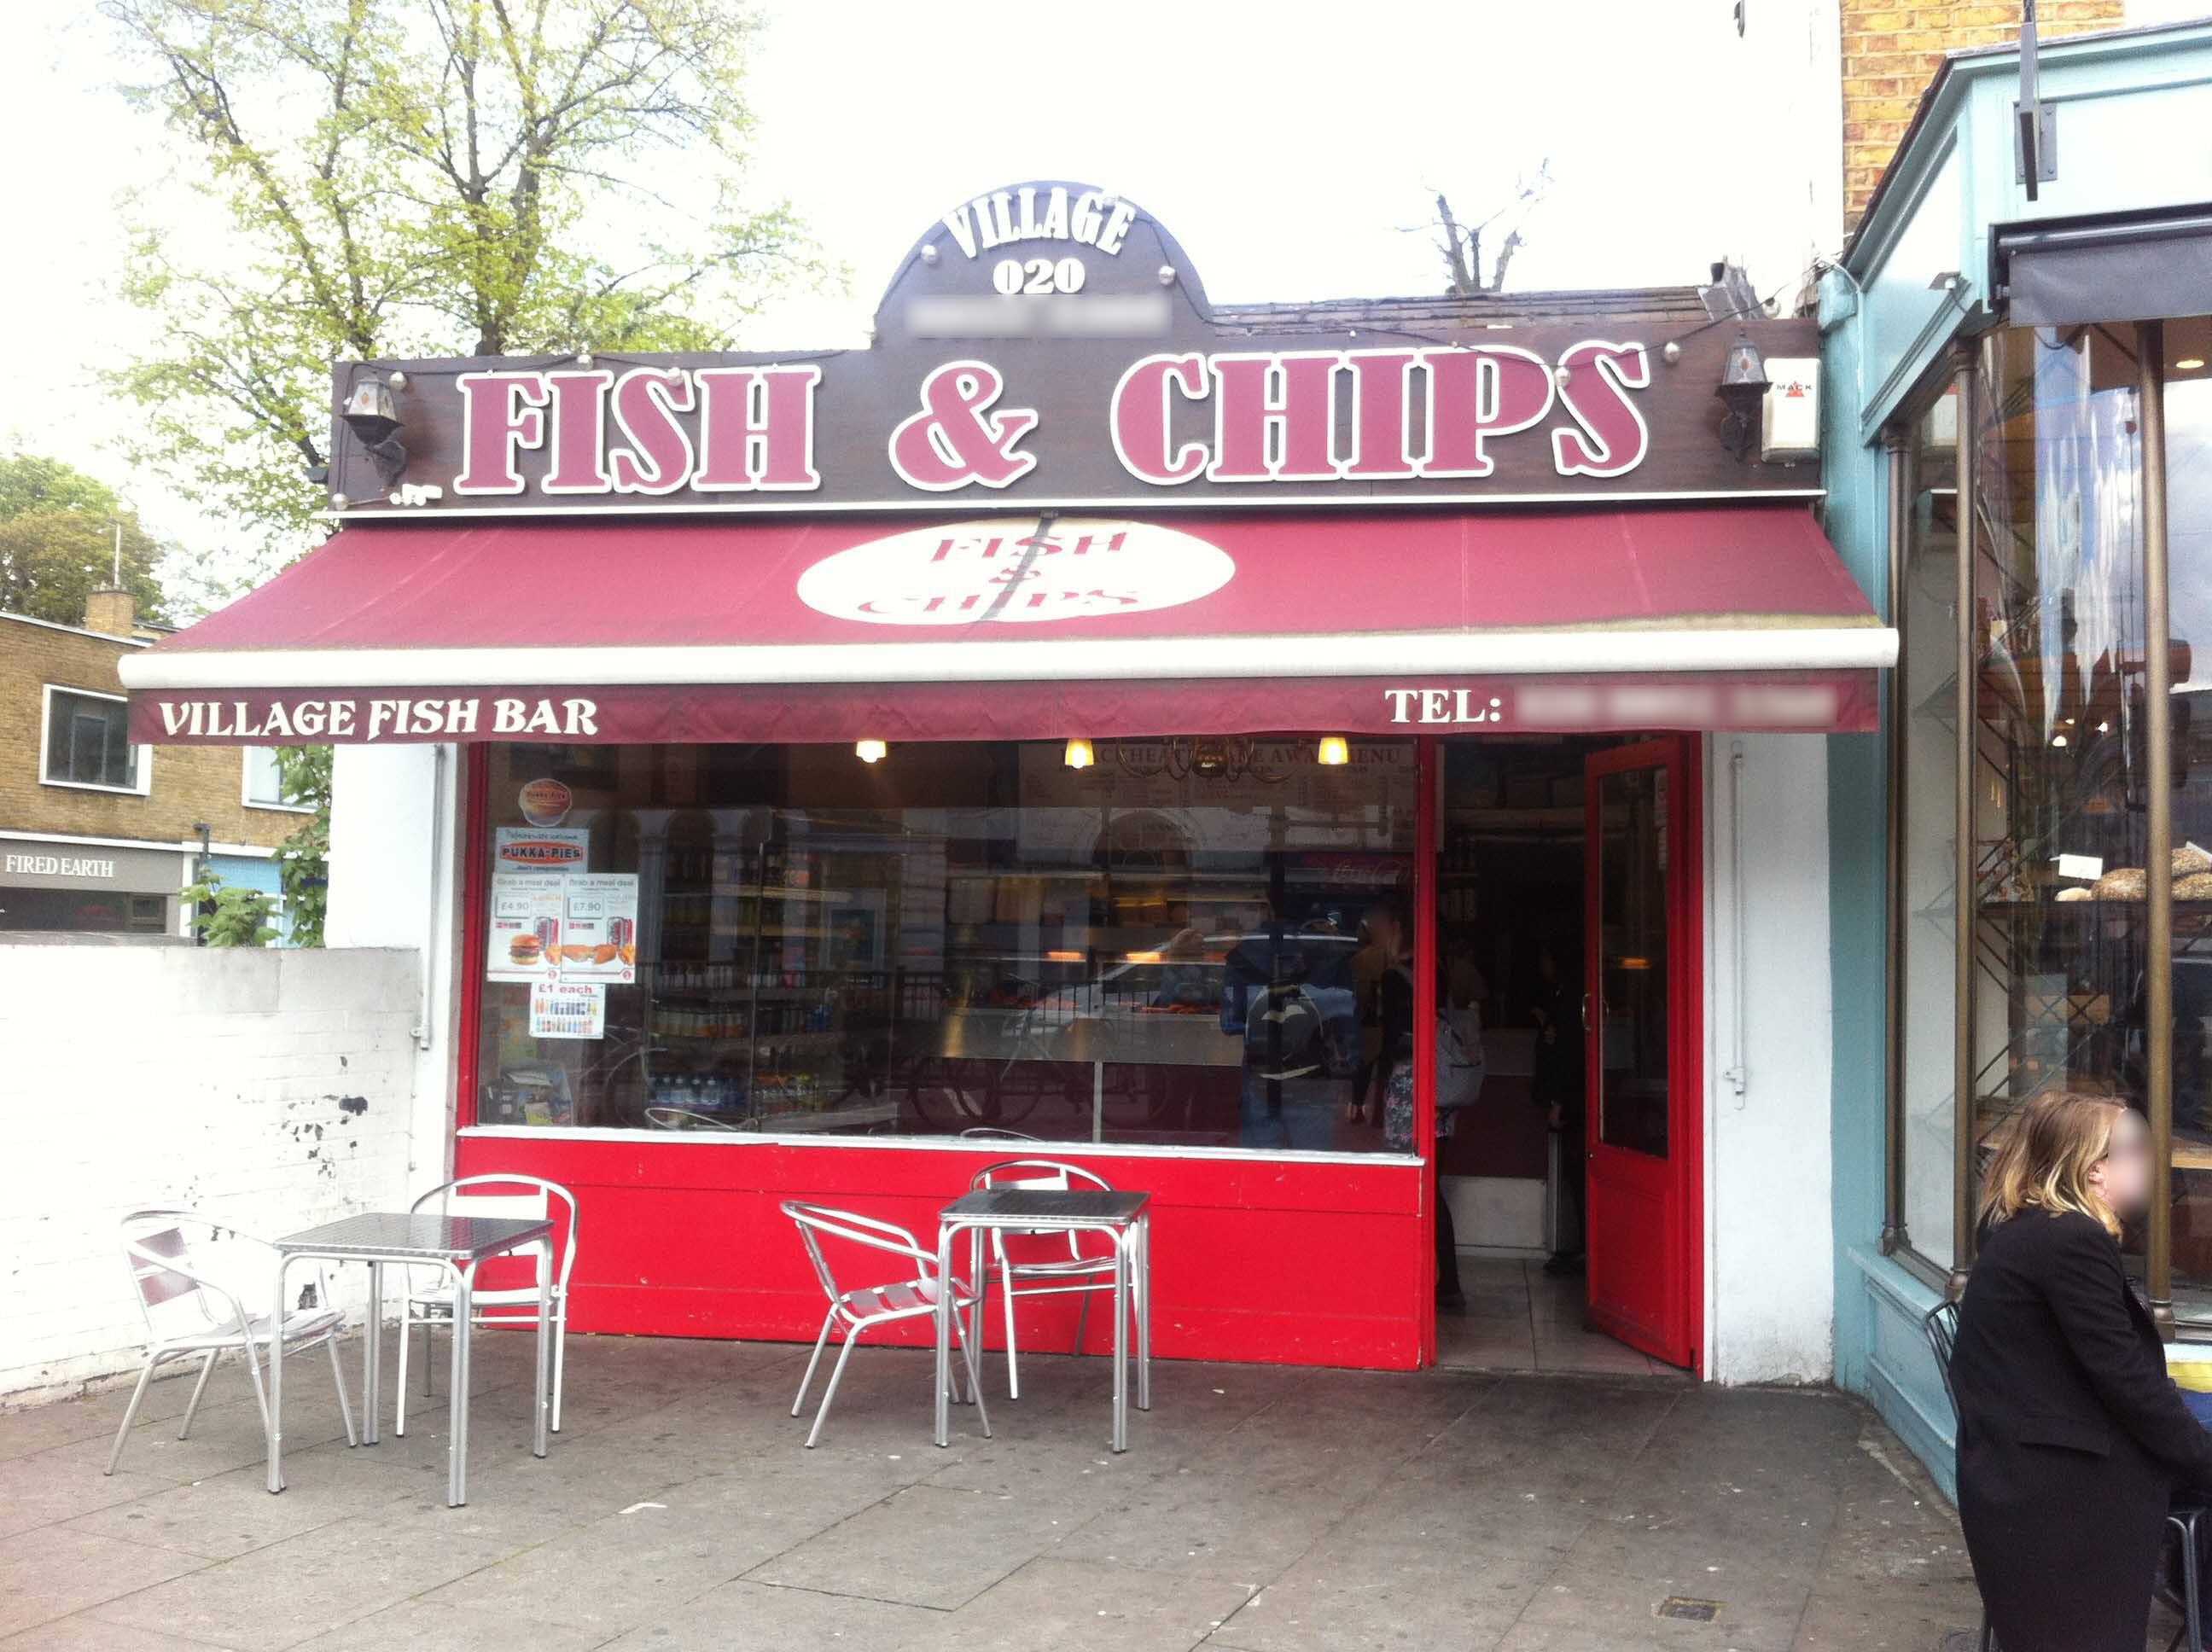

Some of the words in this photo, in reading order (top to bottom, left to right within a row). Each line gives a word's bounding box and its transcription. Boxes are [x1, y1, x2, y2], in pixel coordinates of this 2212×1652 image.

[941, 187, 1137, 259] VILLAGE
[992, 258, 1086, 295] 020
[453, 365, 822, 496] FISH
[888, 359, 1039, 492] &
[1110, 340, 1650, 485] CHIPS
[930, 532, 1127, 562] FISH
[858, 589, 1139, 614] CHIPS
[159, 700, 356, 736] VILLAGE
[367, 699, 480, 741] FISH
[492, 698, 598, 736] BAR
[1384, 689, 1502, 724] TEL:
[6, 854, 59, 875] FIRED
[60, 858, 114, 877] EARTH
[502, 846, 581, 859] PUKKA-PIES
[538, 984, 553, 993] £1
[559, 985, 592, 994] each
